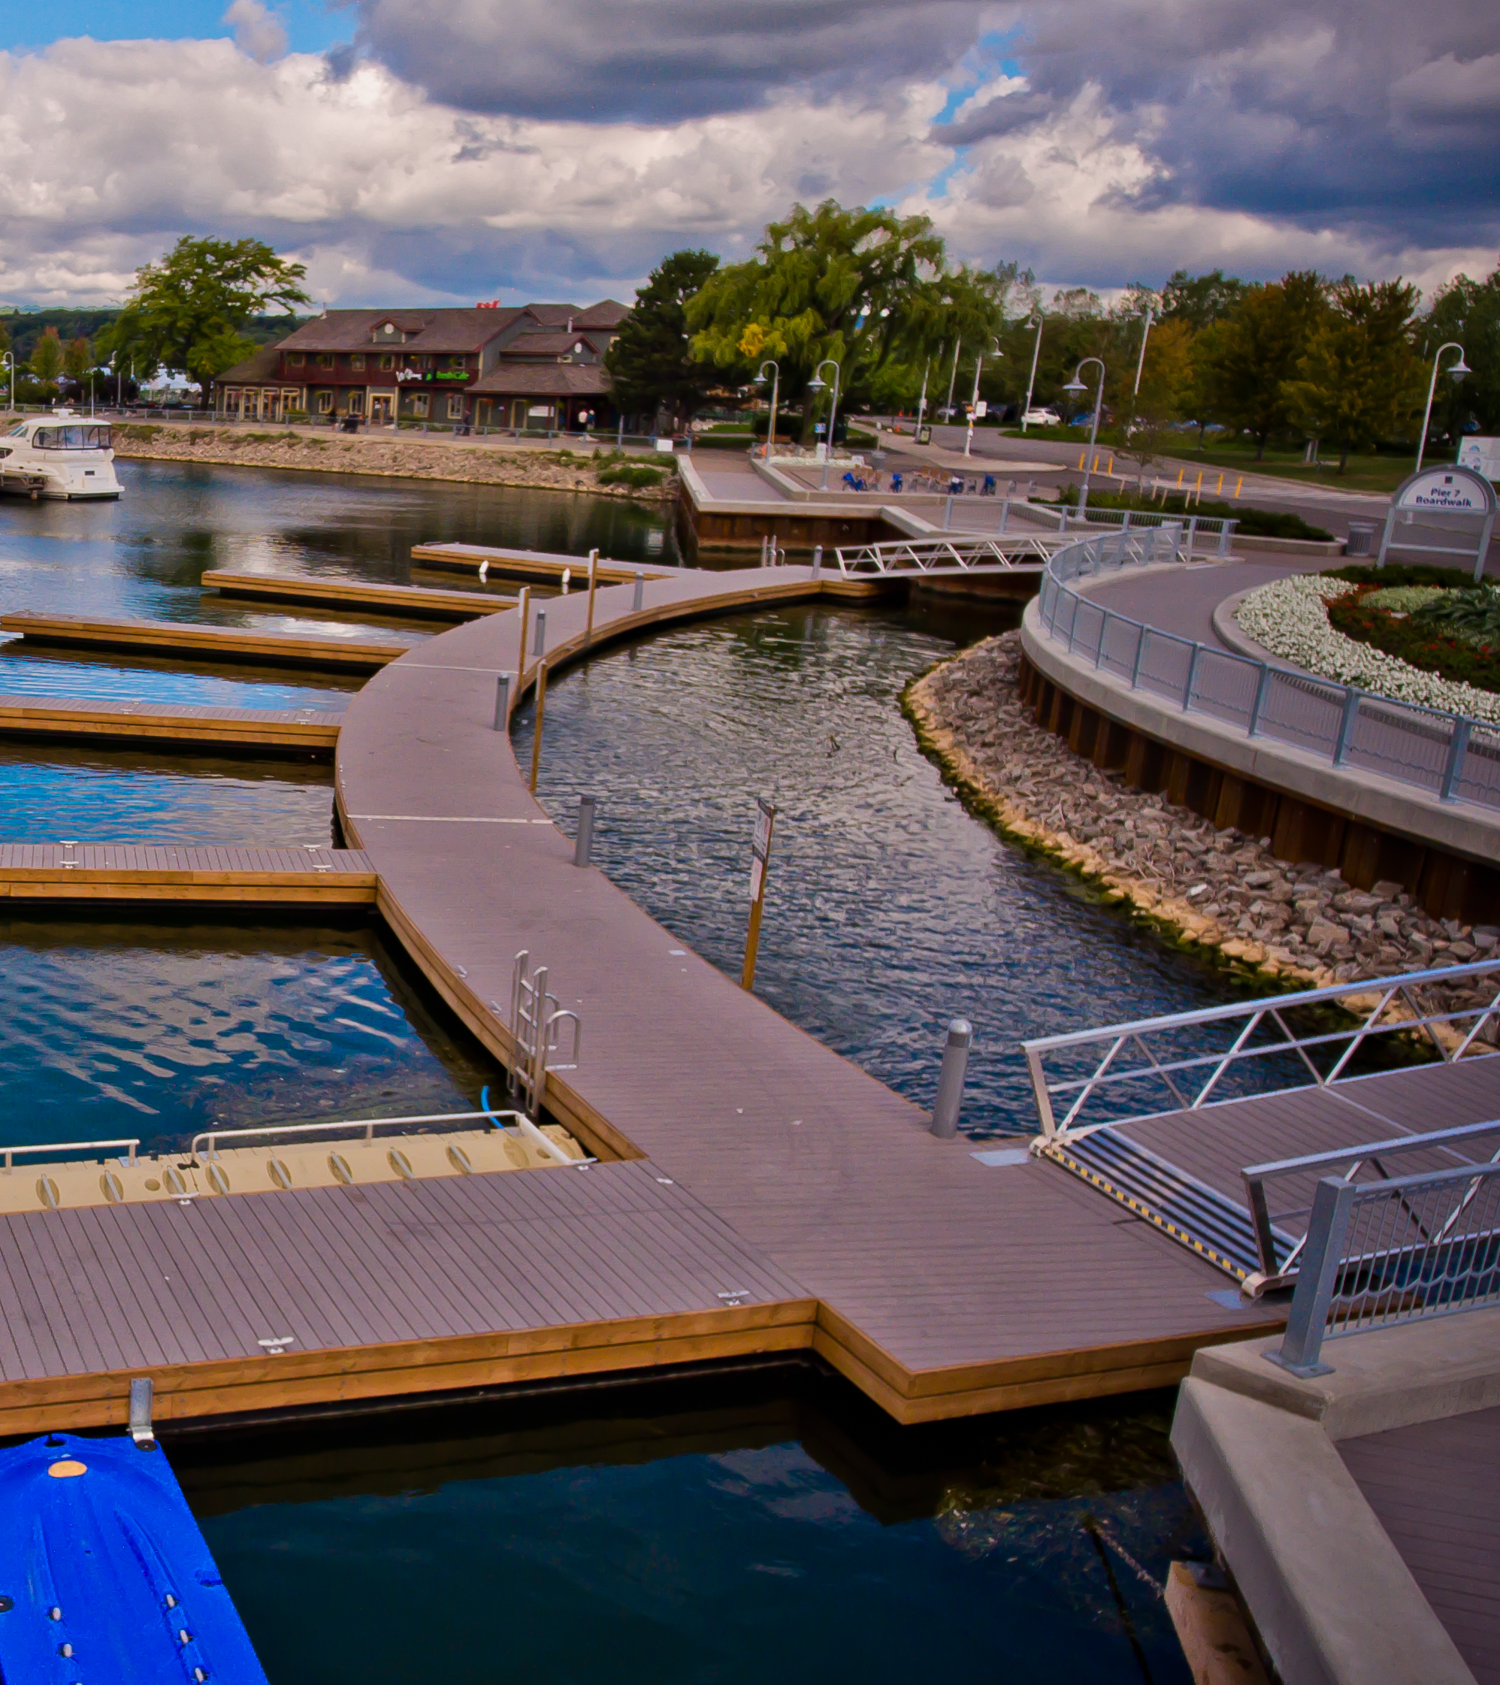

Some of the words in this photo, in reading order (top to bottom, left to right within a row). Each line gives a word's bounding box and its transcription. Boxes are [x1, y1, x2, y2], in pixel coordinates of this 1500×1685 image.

[1430, 487, 1451, 497] Pier
[1454, 489, 1461, 498] 7
[1416, 495, 1472, 507] Boardwalk
